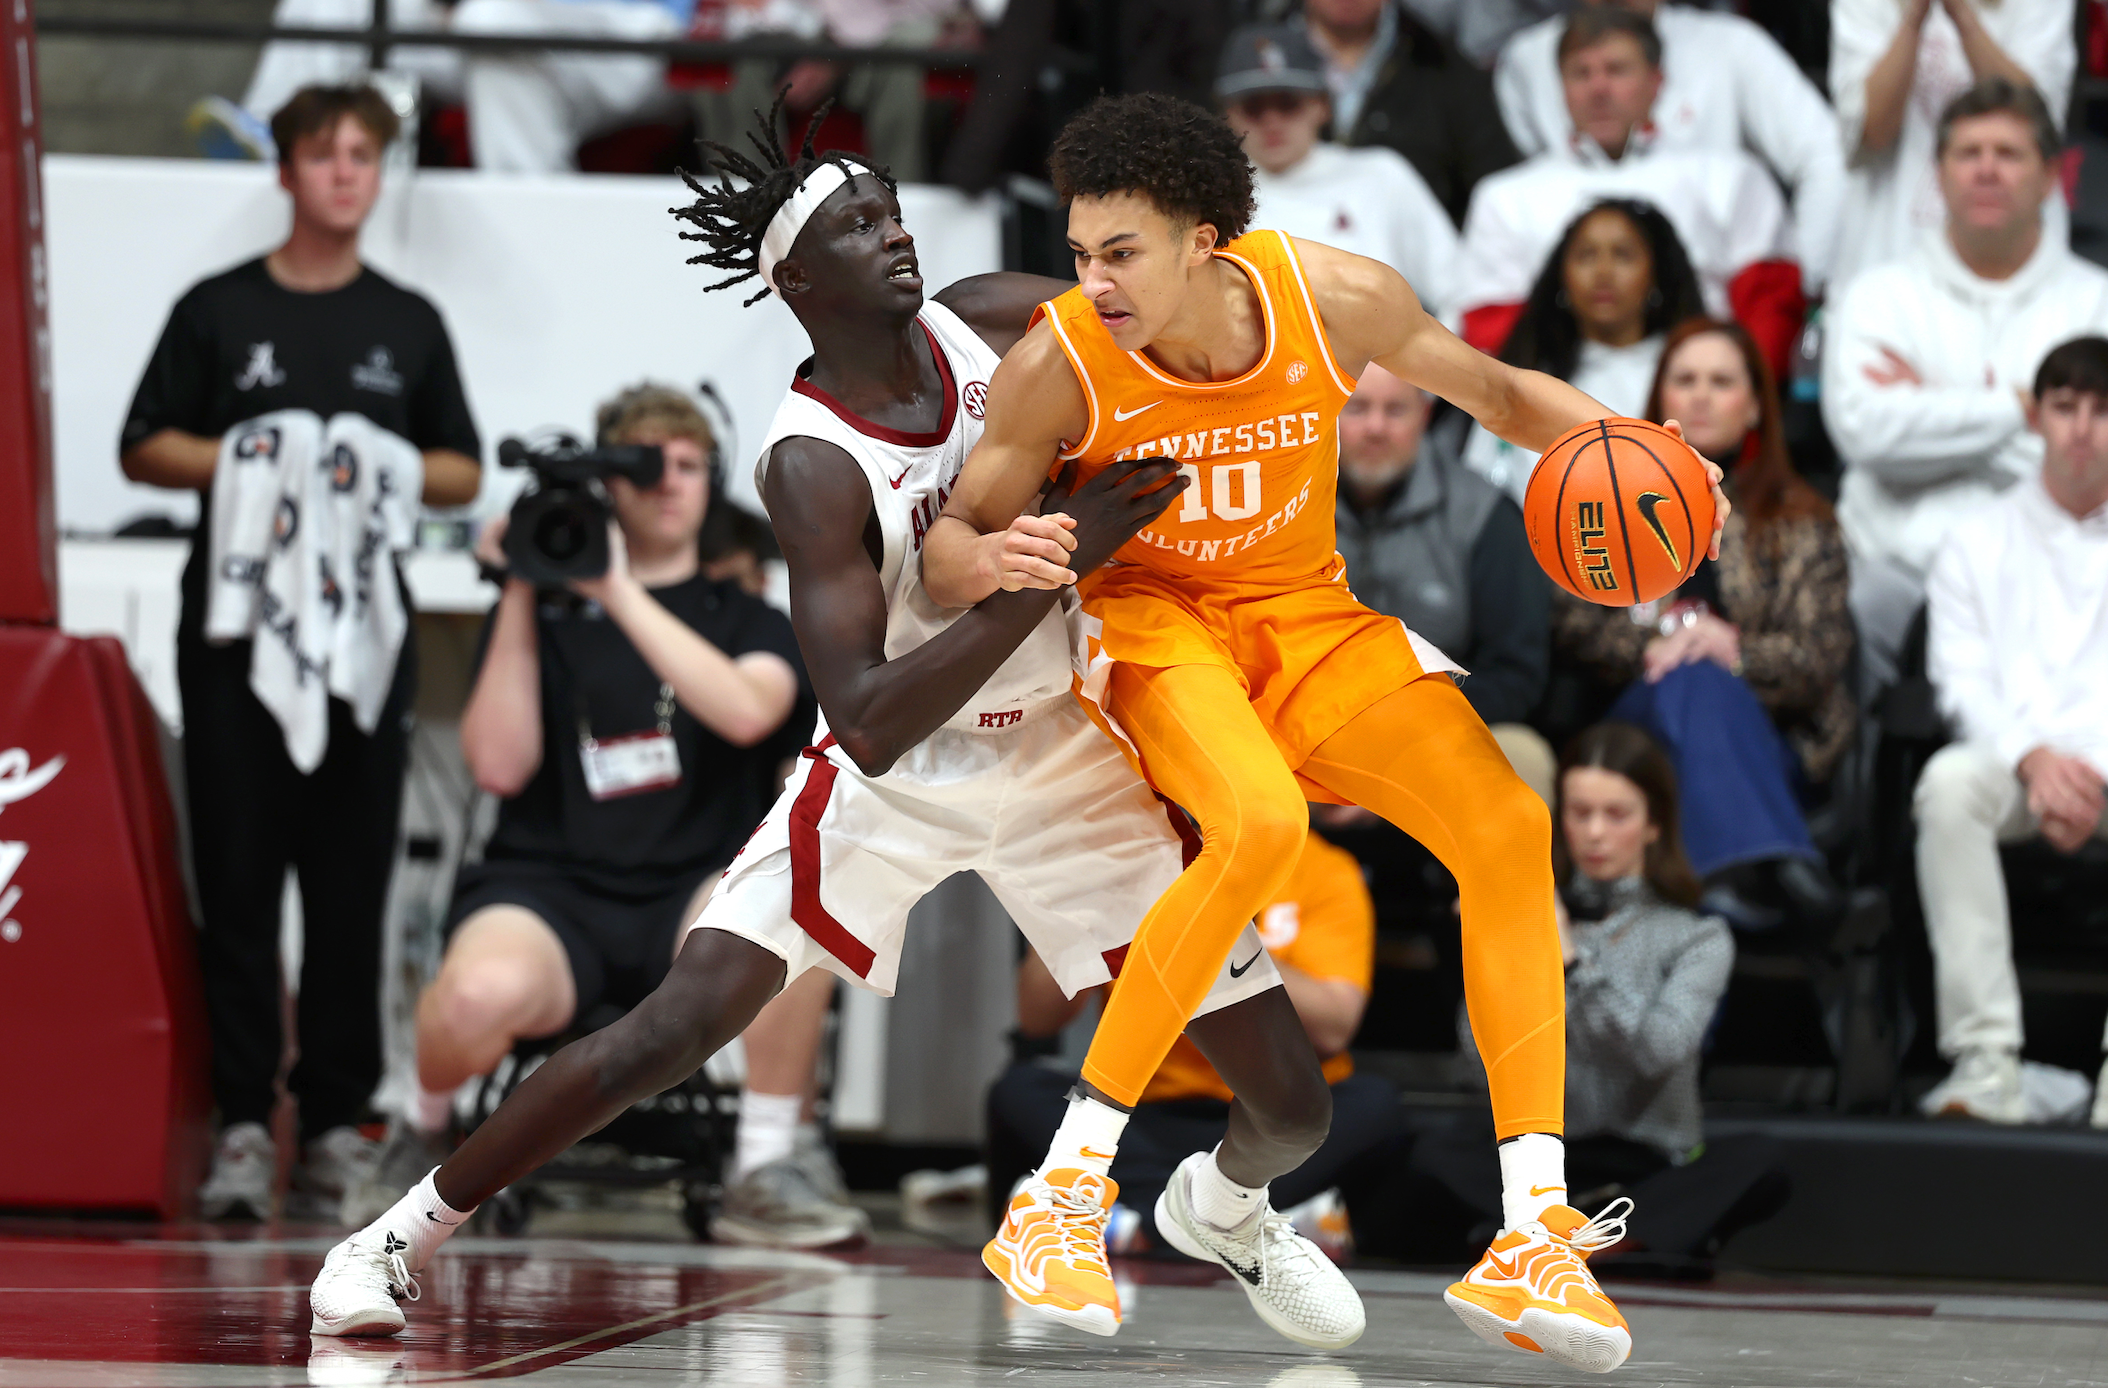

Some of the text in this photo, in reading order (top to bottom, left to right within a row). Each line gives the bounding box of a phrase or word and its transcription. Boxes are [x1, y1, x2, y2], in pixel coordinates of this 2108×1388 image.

[1287, 361, 1307, 384] SEC
[1136, 475, 1312, 562] OLUNTEERS
[1175, 460, 1261, 523] 10
[1579, 501, 1620, 590] ELITE
[977, 709, 1023, 728] RTR
